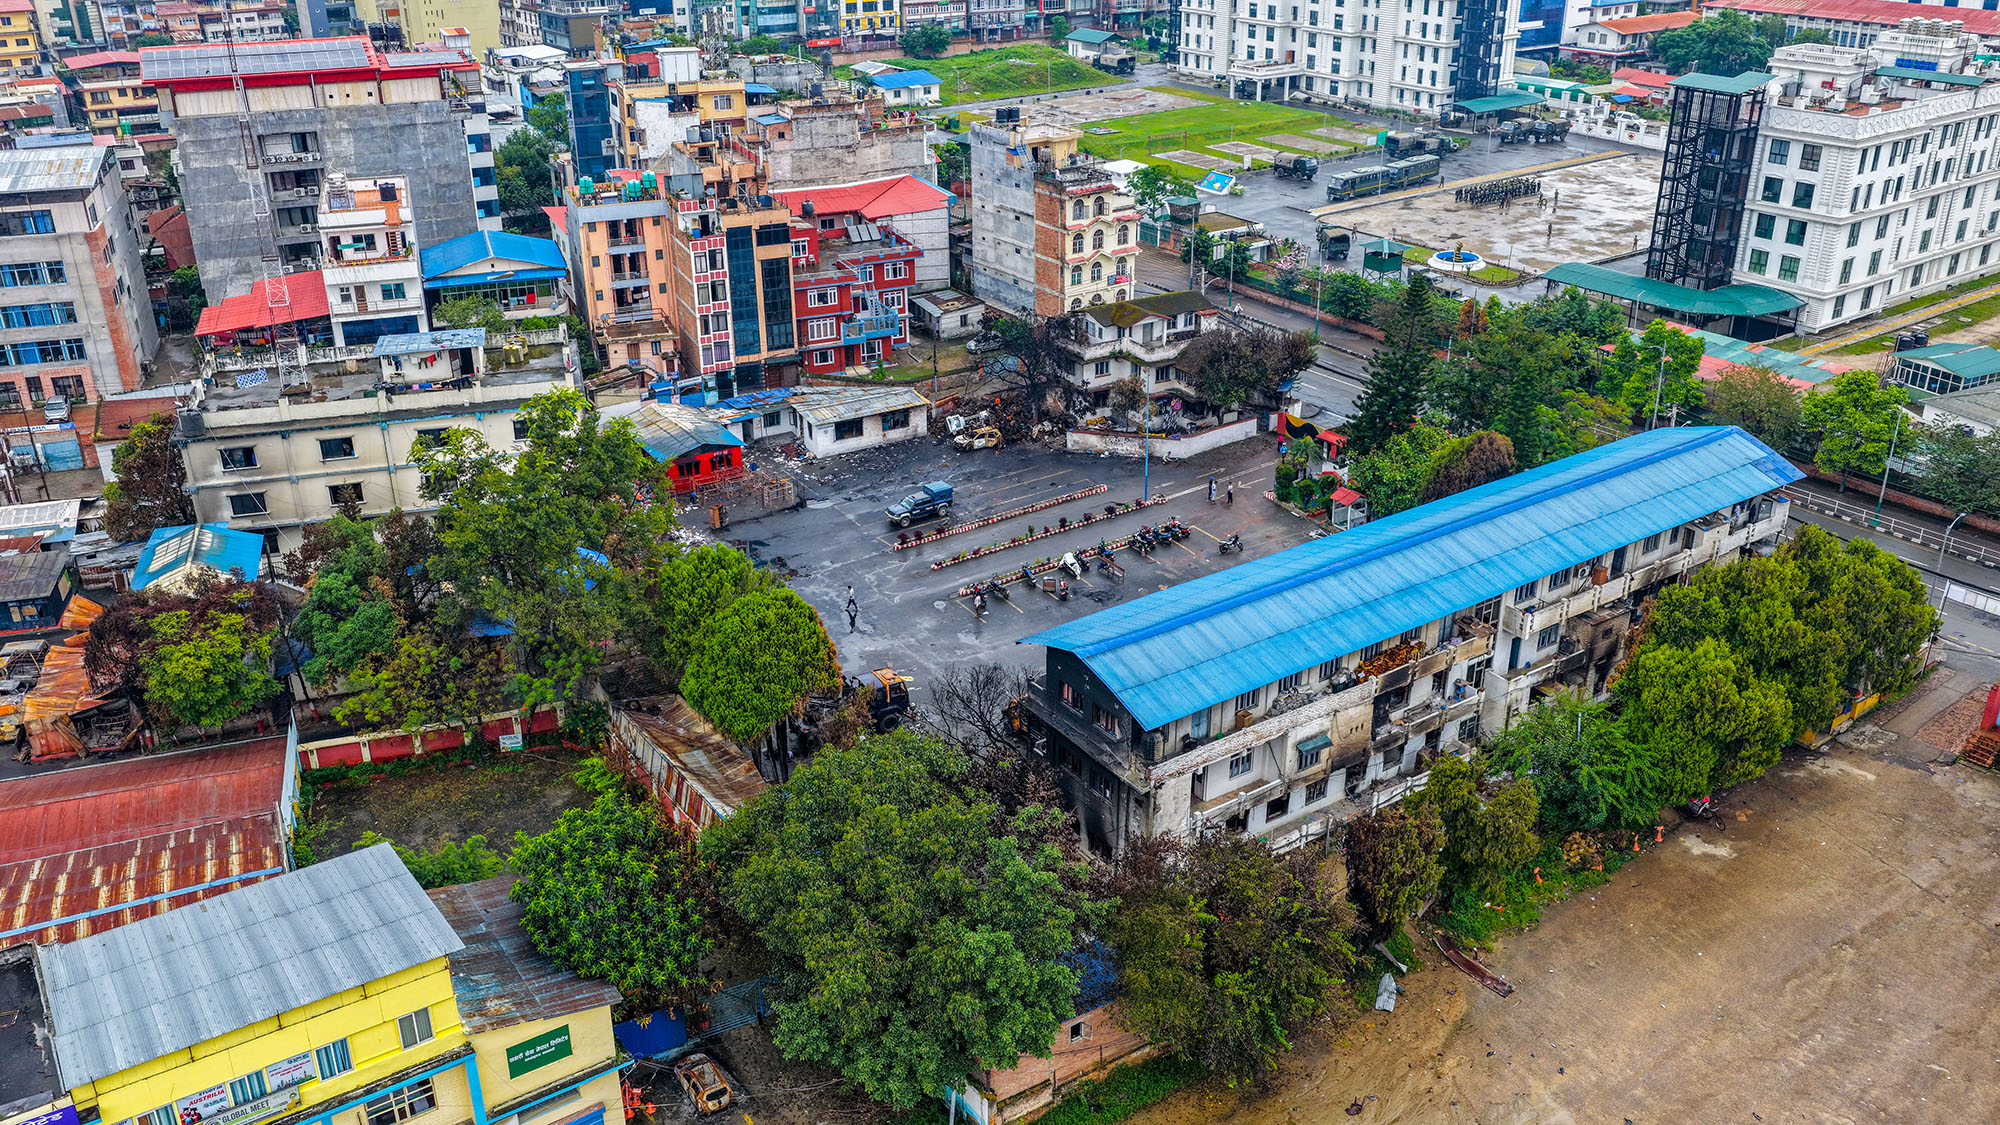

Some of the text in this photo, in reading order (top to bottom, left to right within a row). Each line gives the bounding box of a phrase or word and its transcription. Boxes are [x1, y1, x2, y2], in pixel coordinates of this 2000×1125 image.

[189, 1089, 225, 1106] AUSTRILIA
[222, 1110, 249, 1123] GLOBAL
[250, 1099, 270, 1112] MEET
